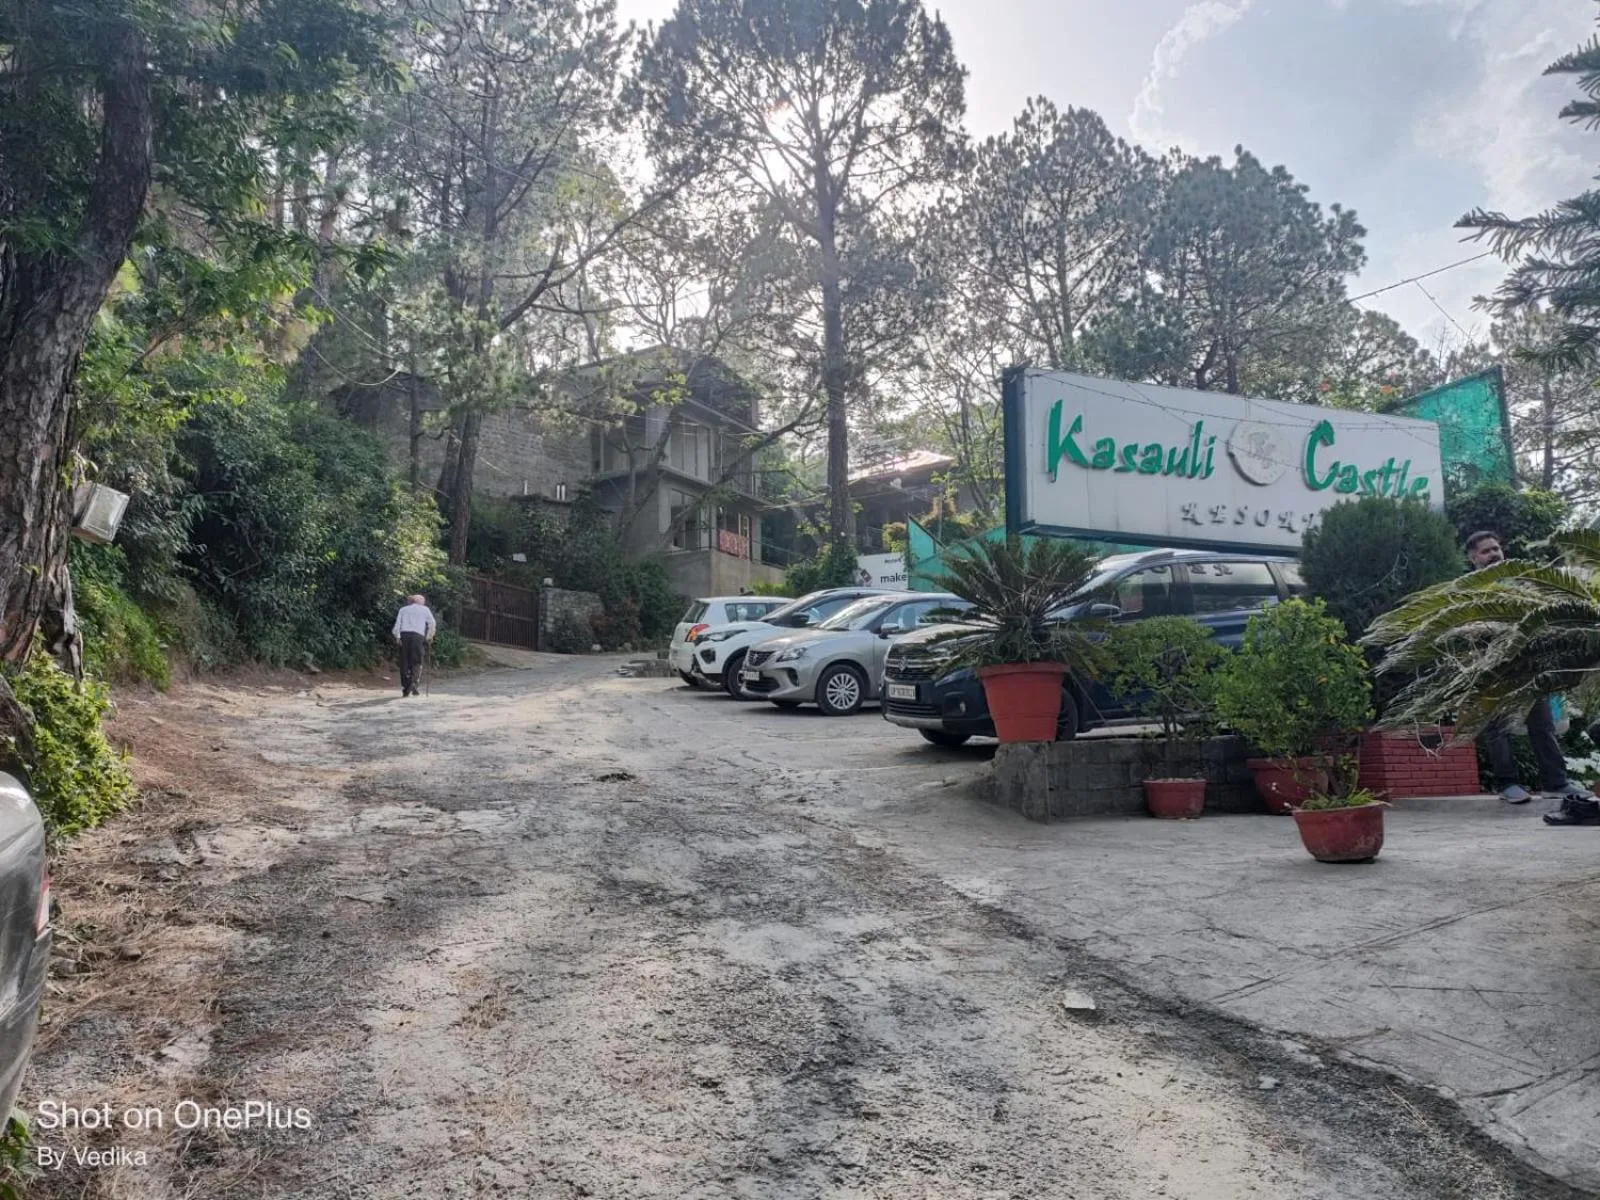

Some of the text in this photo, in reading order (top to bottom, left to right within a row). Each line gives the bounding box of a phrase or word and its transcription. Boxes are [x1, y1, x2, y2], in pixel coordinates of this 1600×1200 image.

[1047, 399, 1216, 483] Kasauli
[1304, 419, 1429, 497] Castle
[880, 572, 907, 584] make
